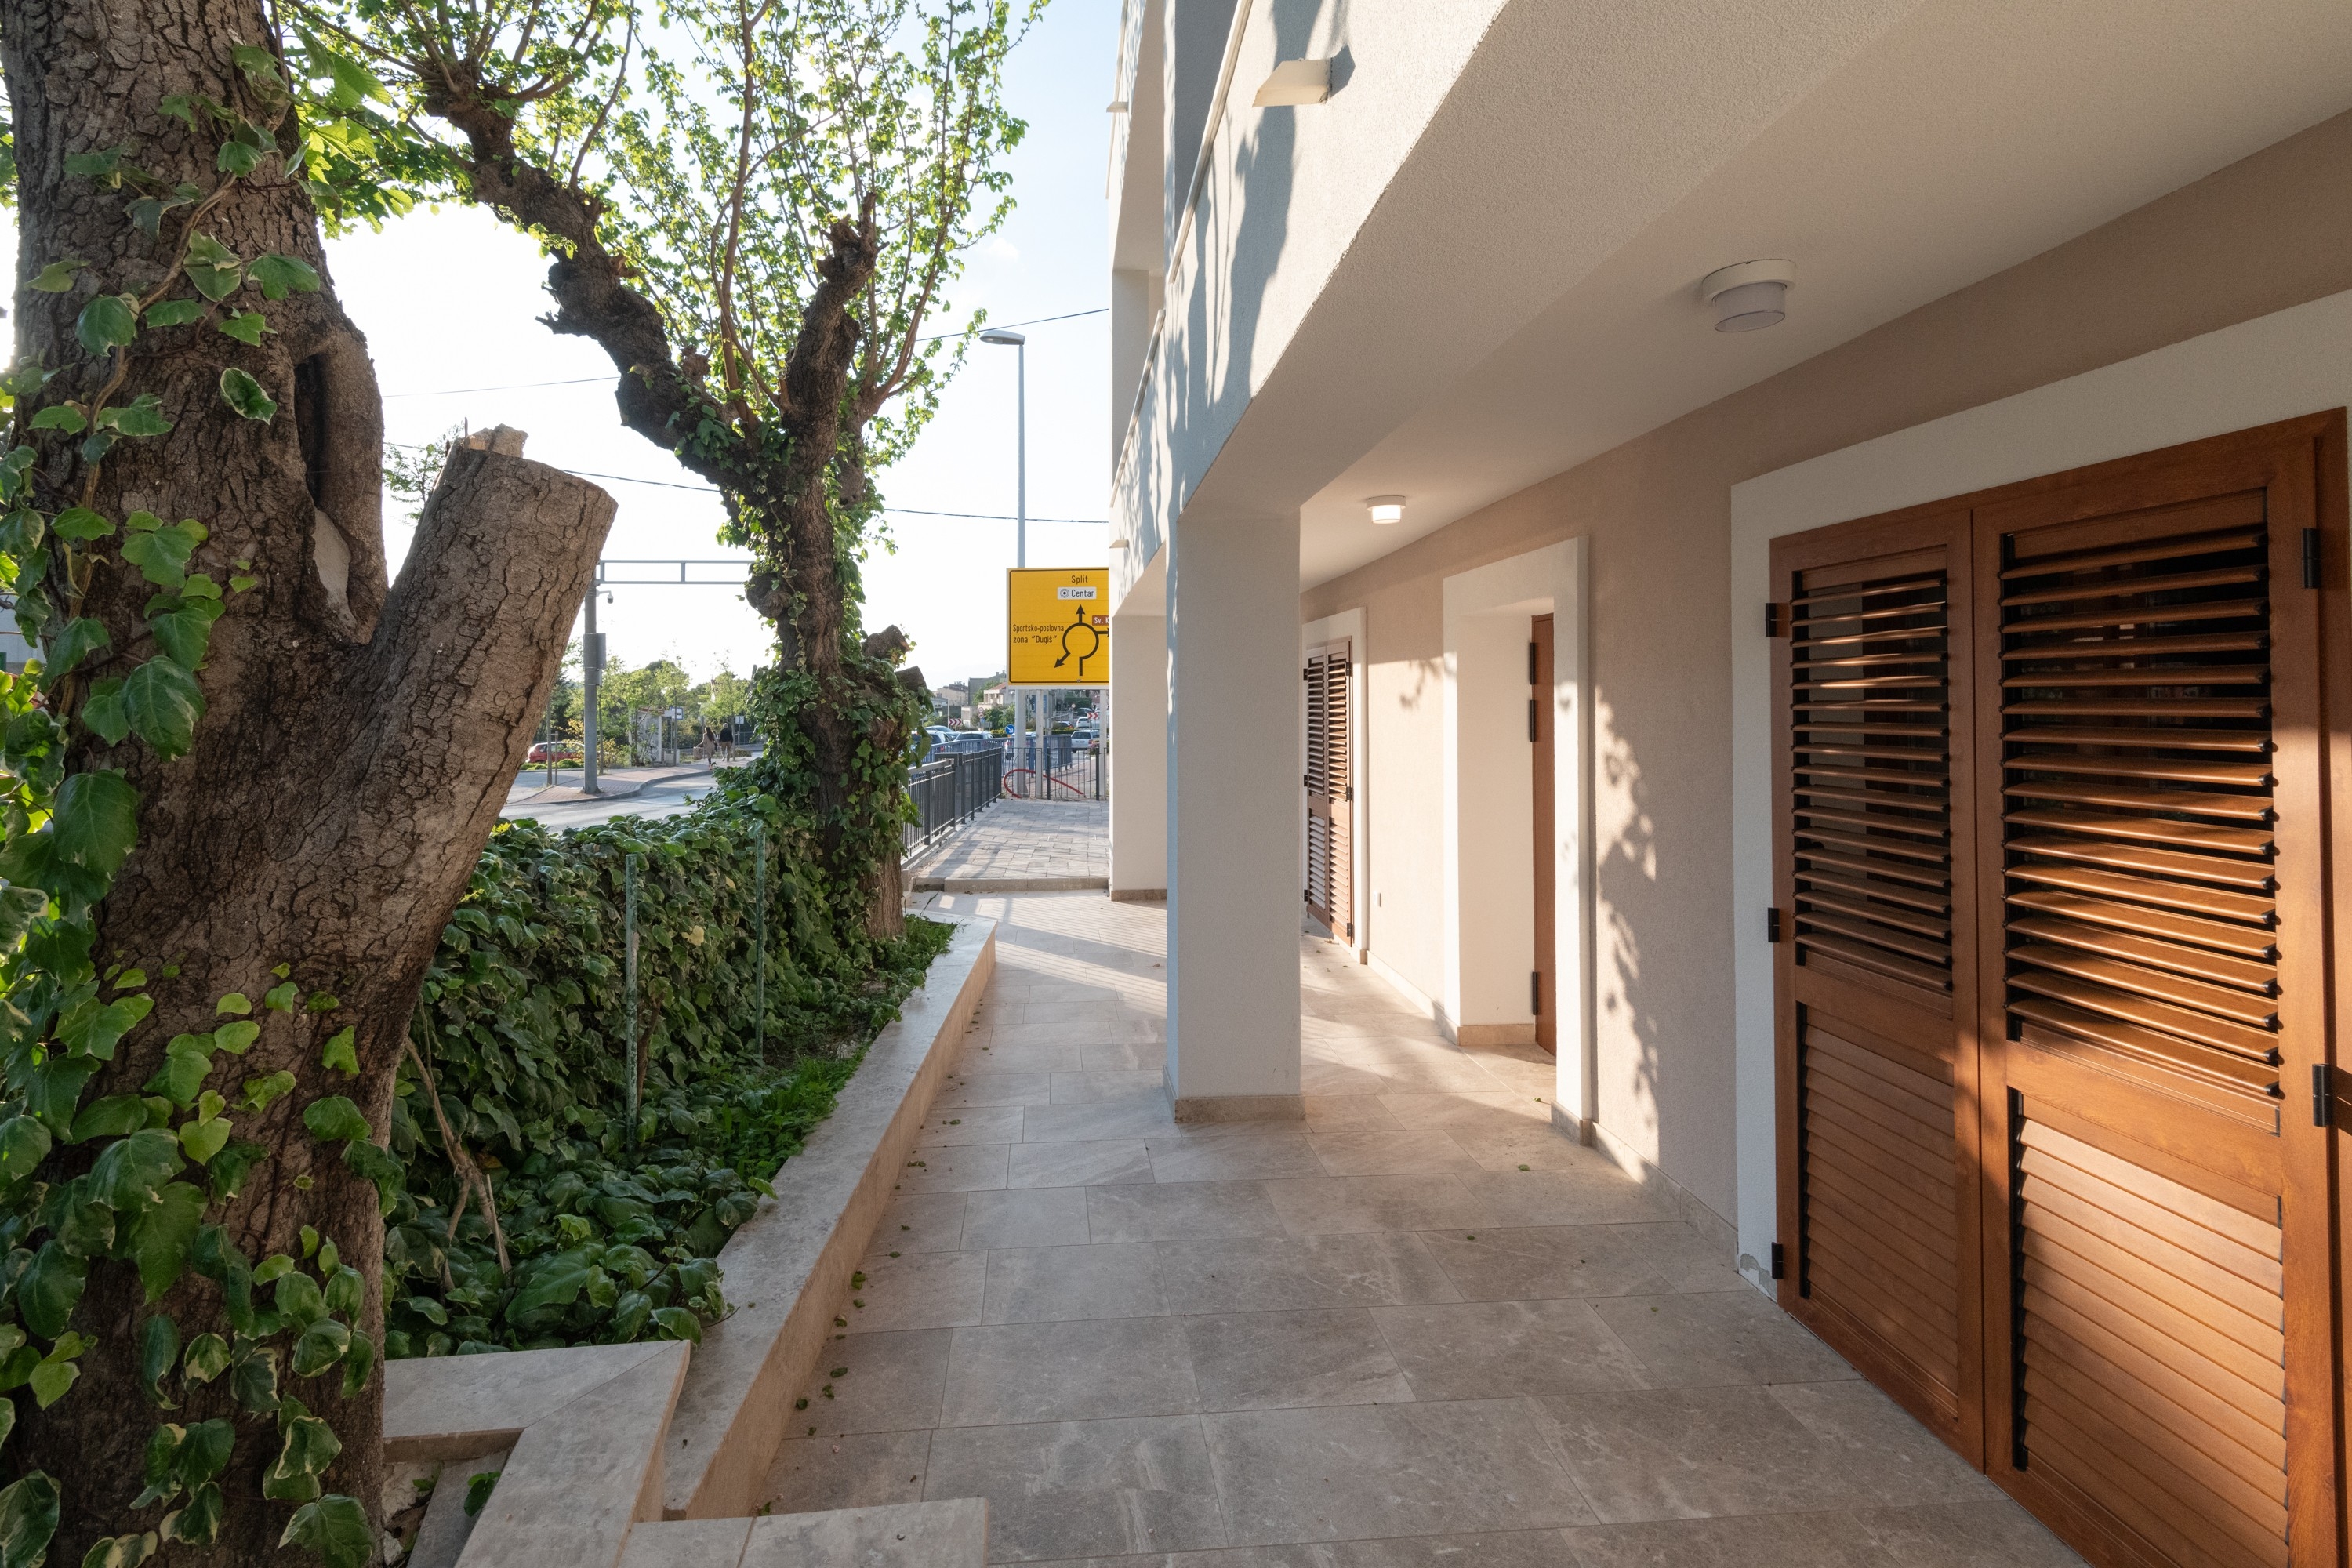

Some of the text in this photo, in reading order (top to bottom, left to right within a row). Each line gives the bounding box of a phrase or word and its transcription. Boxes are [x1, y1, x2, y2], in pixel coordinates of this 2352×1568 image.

[1071, 575, 1088, 585] Split
[1071, 589, 1094, 597] Centar
[1012, 624, 1064, 633] Sportsko-poslovna
